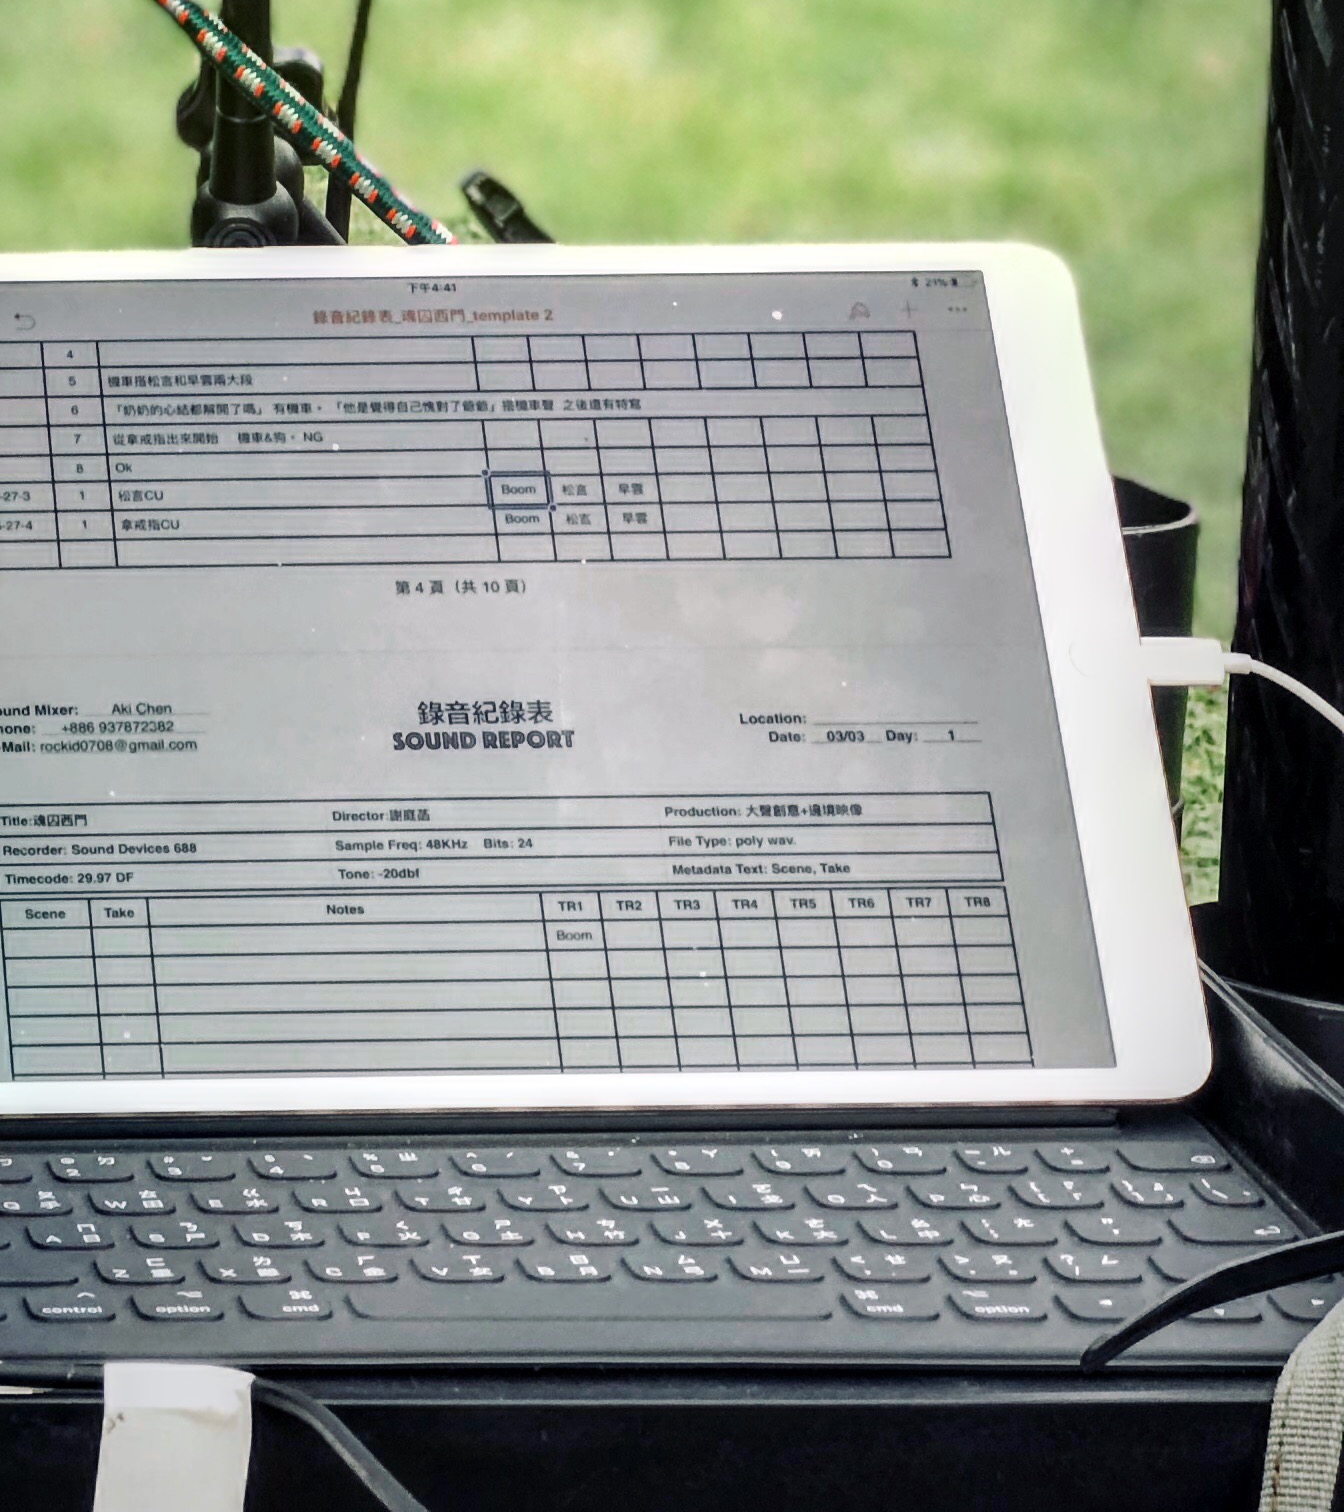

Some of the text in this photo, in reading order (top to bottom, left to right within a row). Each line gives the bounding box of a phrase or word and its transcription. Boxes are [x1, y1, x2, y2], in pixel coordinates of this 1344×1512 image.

[543, 308, 554, 322] 2
[67, 376, 76, 387] 5
[70, 405, 79, 416] 6
[73, 433, 82, 445] 7
[303, 431, 324, 442] NG
[115, 462, 133, 474] Ok
[79, 489, 86, 501] 1
[501, 483, 537, 495] Boom
[81, 519, 88, 530] 1
[504, 513, 540, 525] Boom
[394, 579, 500, 596] 第 4 頁 10
[34, 703, 79, 717] Mixer:
[111, 702, 132, 716] Aki
[135, 702, 173, 716] Chen
[417, 699, 554, 726] 錄音紀錄表
[739, 713, 807, 725] Location:
[60, 722, 95, 735] +886
[98, 720, 175, 734] 937872382
[392, 729, 575, 751] SOUND REPORT
[768, 729, 955, 746] Date: 03/03 Day: 1
[664, 804, 742, 818] Production:
[2, 842, 198, 857] Recorder: Sound Devices 688
[335, 837, 533, 854] Sample Freq: 48KHz Bits: 24
[668, 835, 693, 848] File
[696, 836, 732, 850] Type:
[735, 835, 764, 850] poly
[338, 868, 374, 880] Tone:
[672, 862, 852, 877] Metadata Text: Scene, Take
[5, 872, 134, 886] Timecode: 29.97 DF
[24, 896, 932, 921] Scene Take Notes TR1 TR2 TR3 TR4 TR5 TR6 TR7
[556, 929, 593, 942] Boom
[41, 1304, 103, 1316] control
[155, 1303, 211, 1317] option
[281, 1302, 320, 1314] cmd
[975, 1304, 1030, 1317] option
